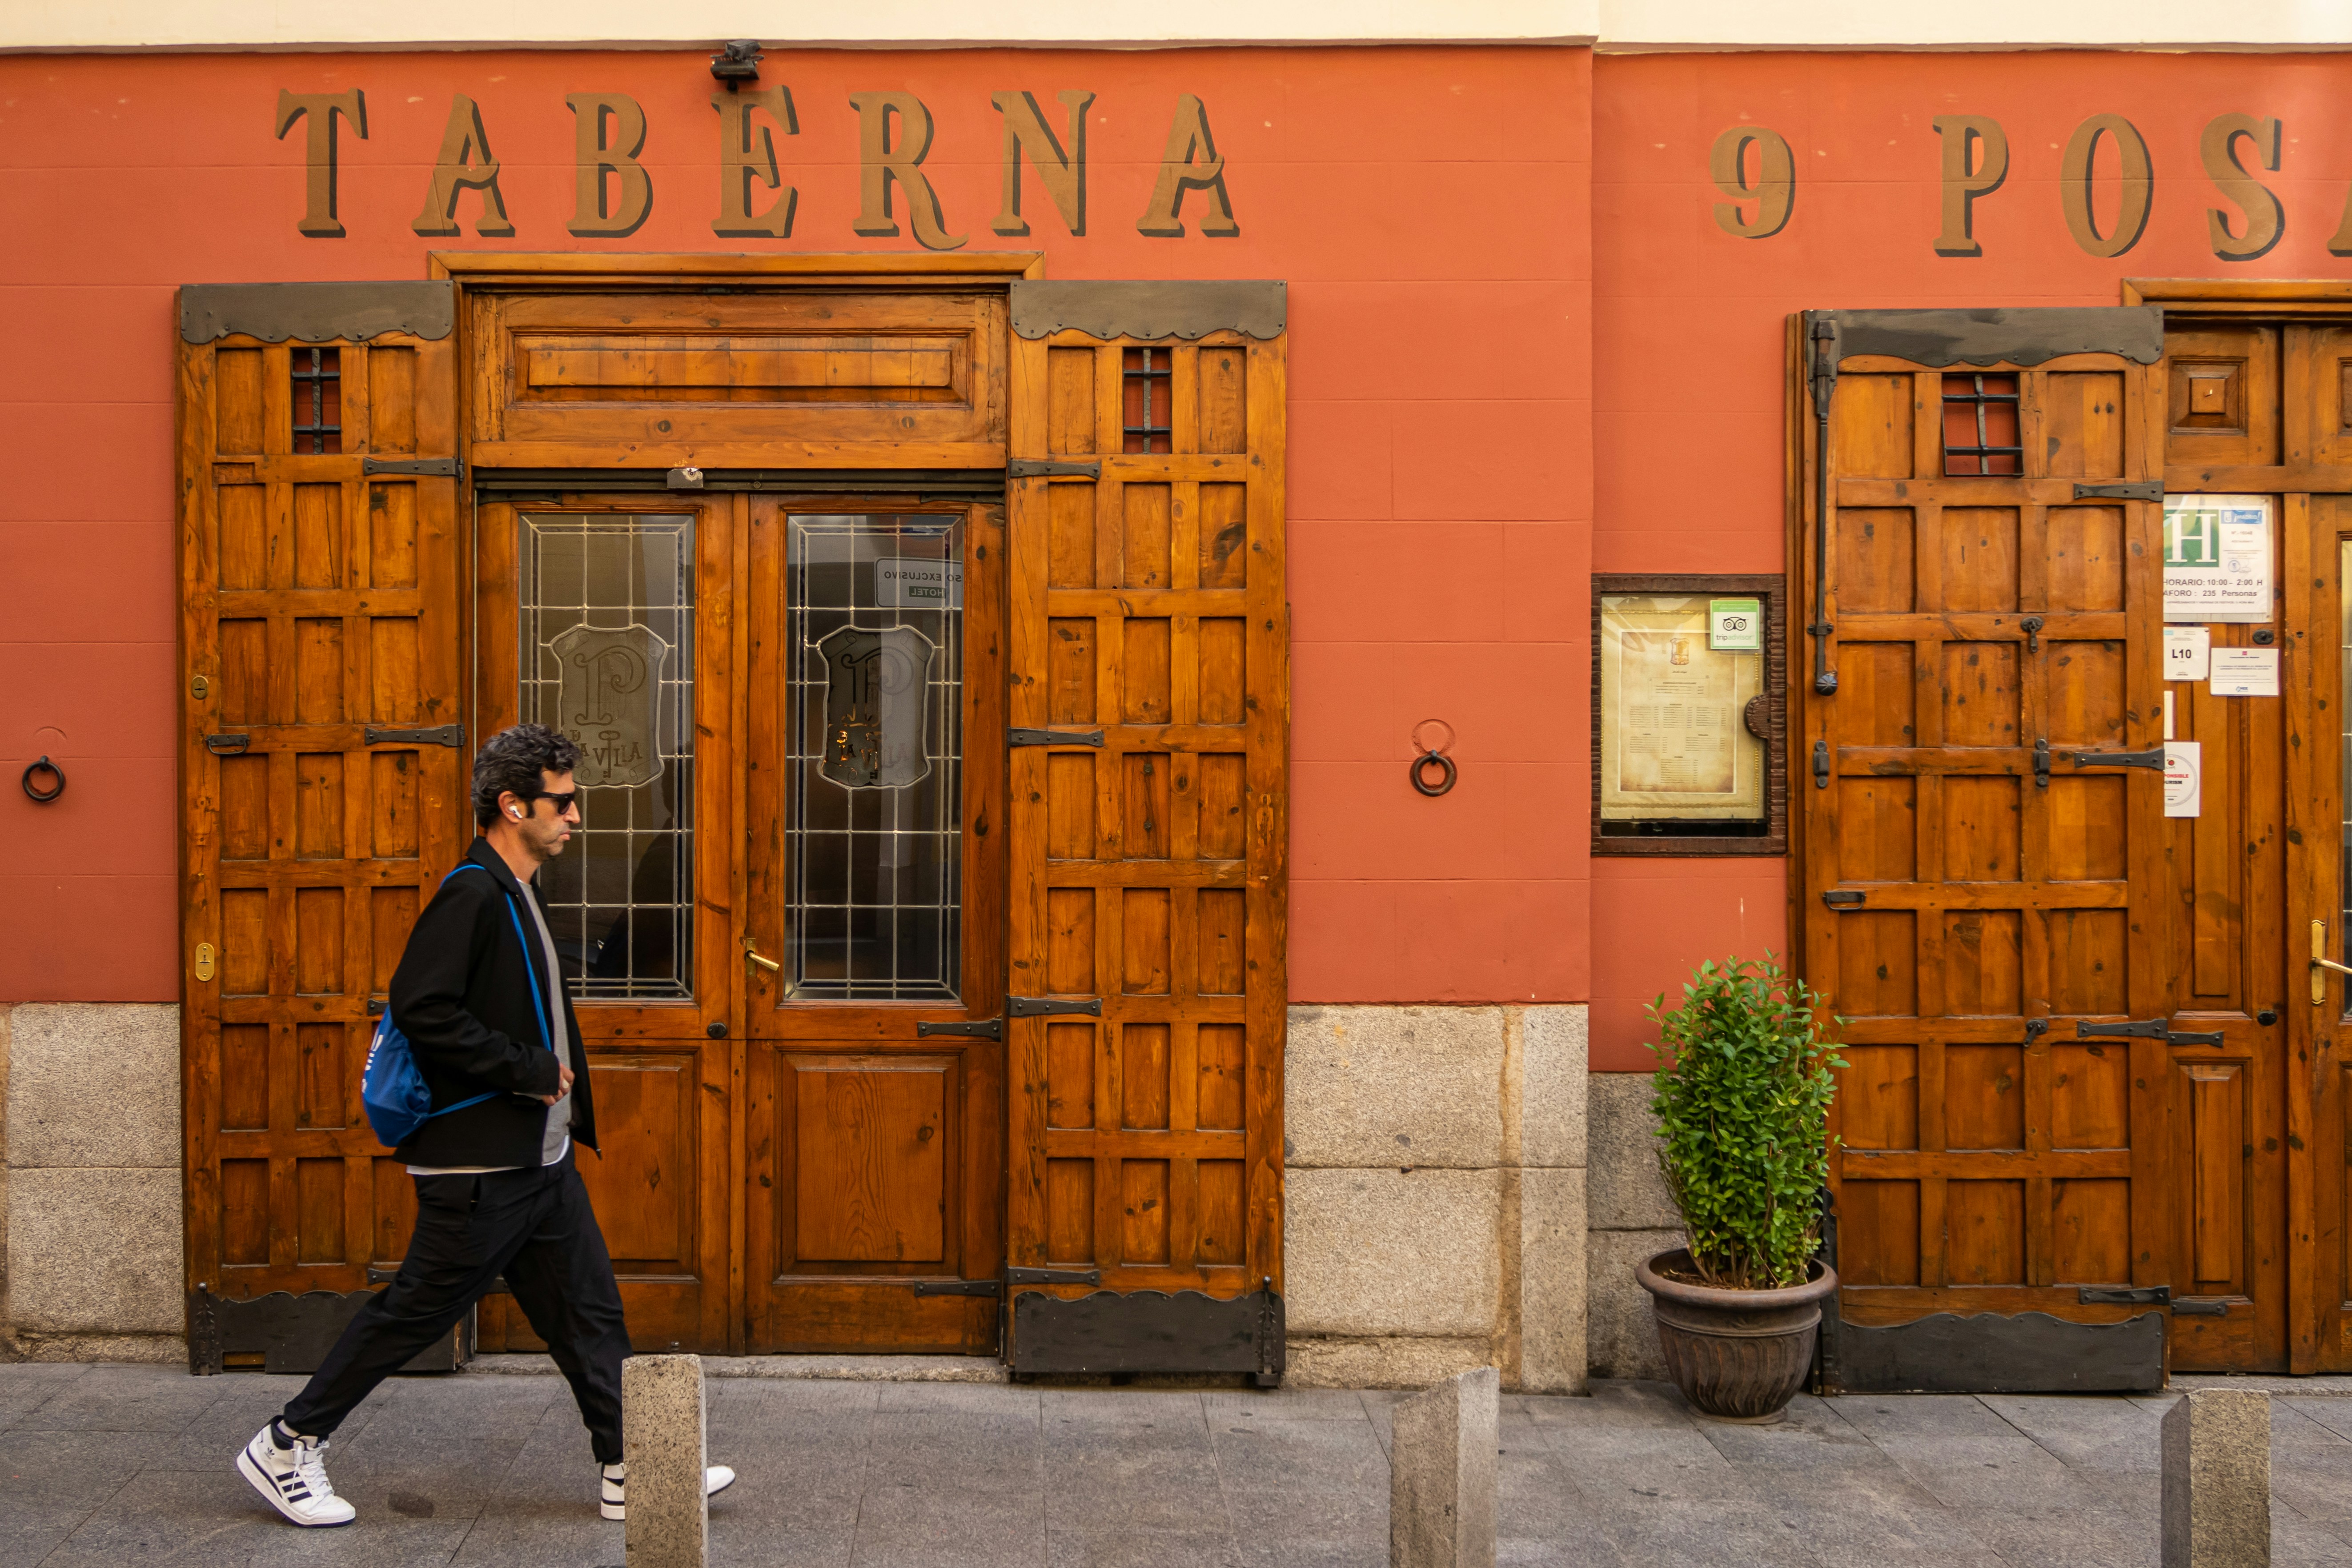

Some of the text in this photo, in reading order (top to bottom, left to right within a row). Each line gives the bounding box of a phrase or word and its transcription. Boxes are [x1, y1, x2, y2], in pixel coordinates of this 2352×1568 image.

[275, 84, 1240, 250] TABERNA
[1710, 126, 1796, 239] 9
[2166, 514, 2217, 563] H
[574, 645, 646, 726] P
[2172, 649, 2191, 658] L10
